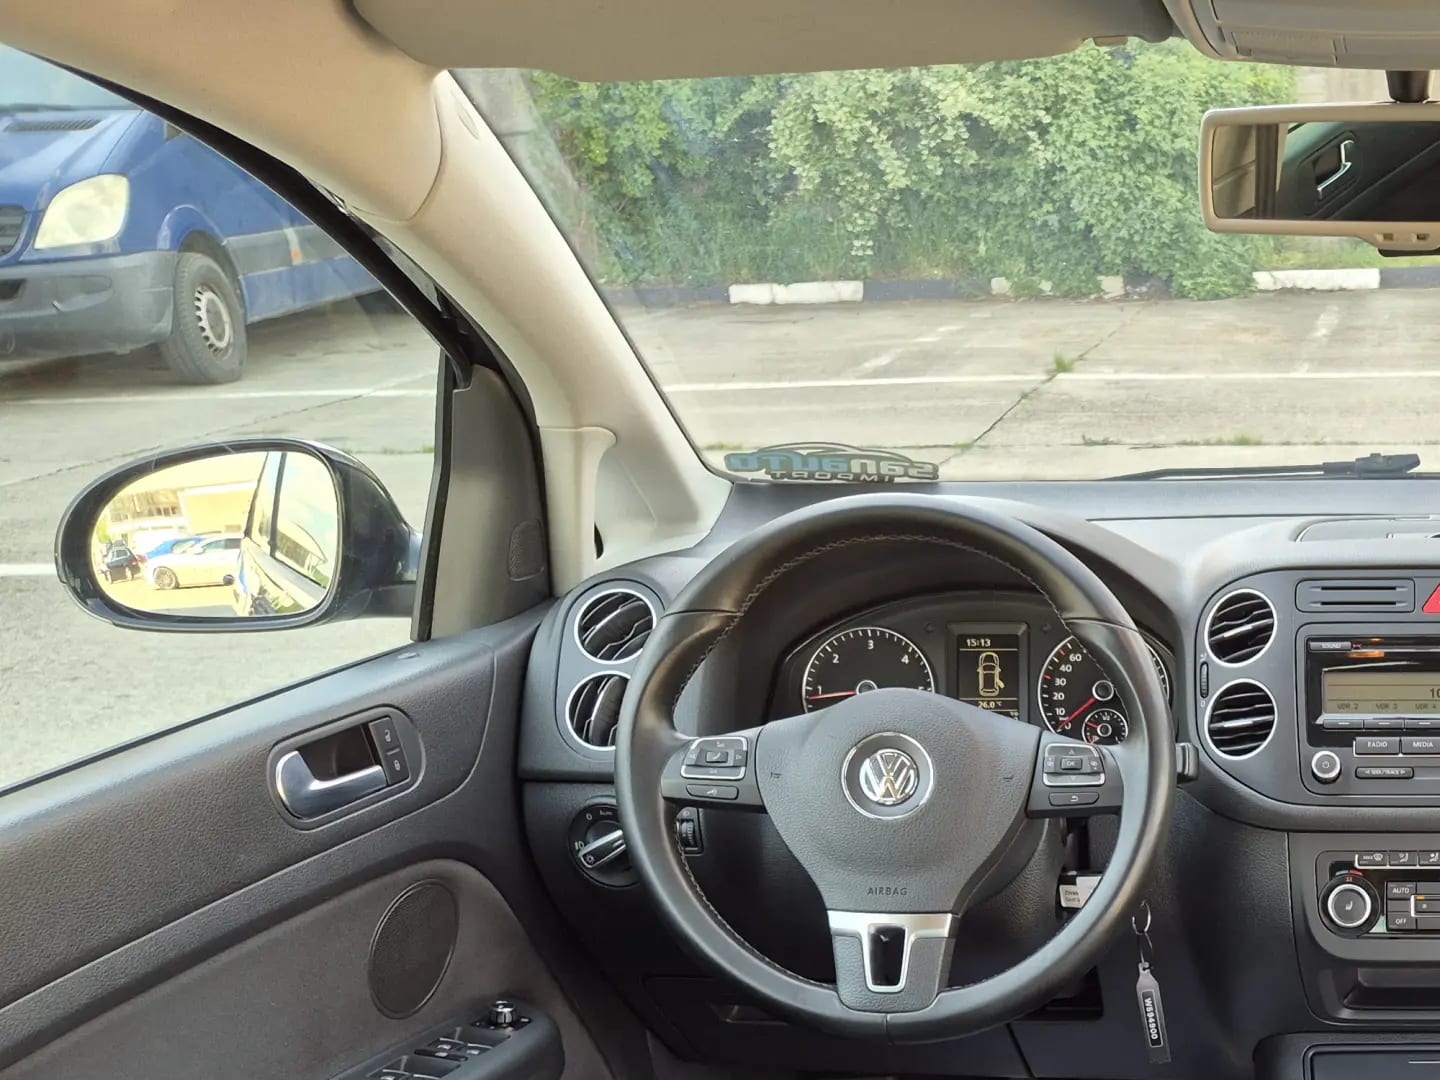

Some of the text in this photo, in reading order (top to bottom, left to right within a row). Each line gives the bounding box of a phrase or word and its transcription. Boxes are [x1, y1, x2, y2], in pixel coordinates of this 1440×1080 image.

[867, 639, 874, 649] 3
[966, 638, 991, 647] 15:13
[832, 654, 840, 663] 2
[901, 654, 909, 664] 4
[1069, 653, 1082, 662] 60
[1059, 664, 1072, 673] 40
[1054, 678, 1066, 687] 30
[817, 685, 822, 694] 1
[1053, 691, 1064, 700] 20
[1055, 707, 1065, 716] 10
[867, 887, 908, 896] AIRBAG
